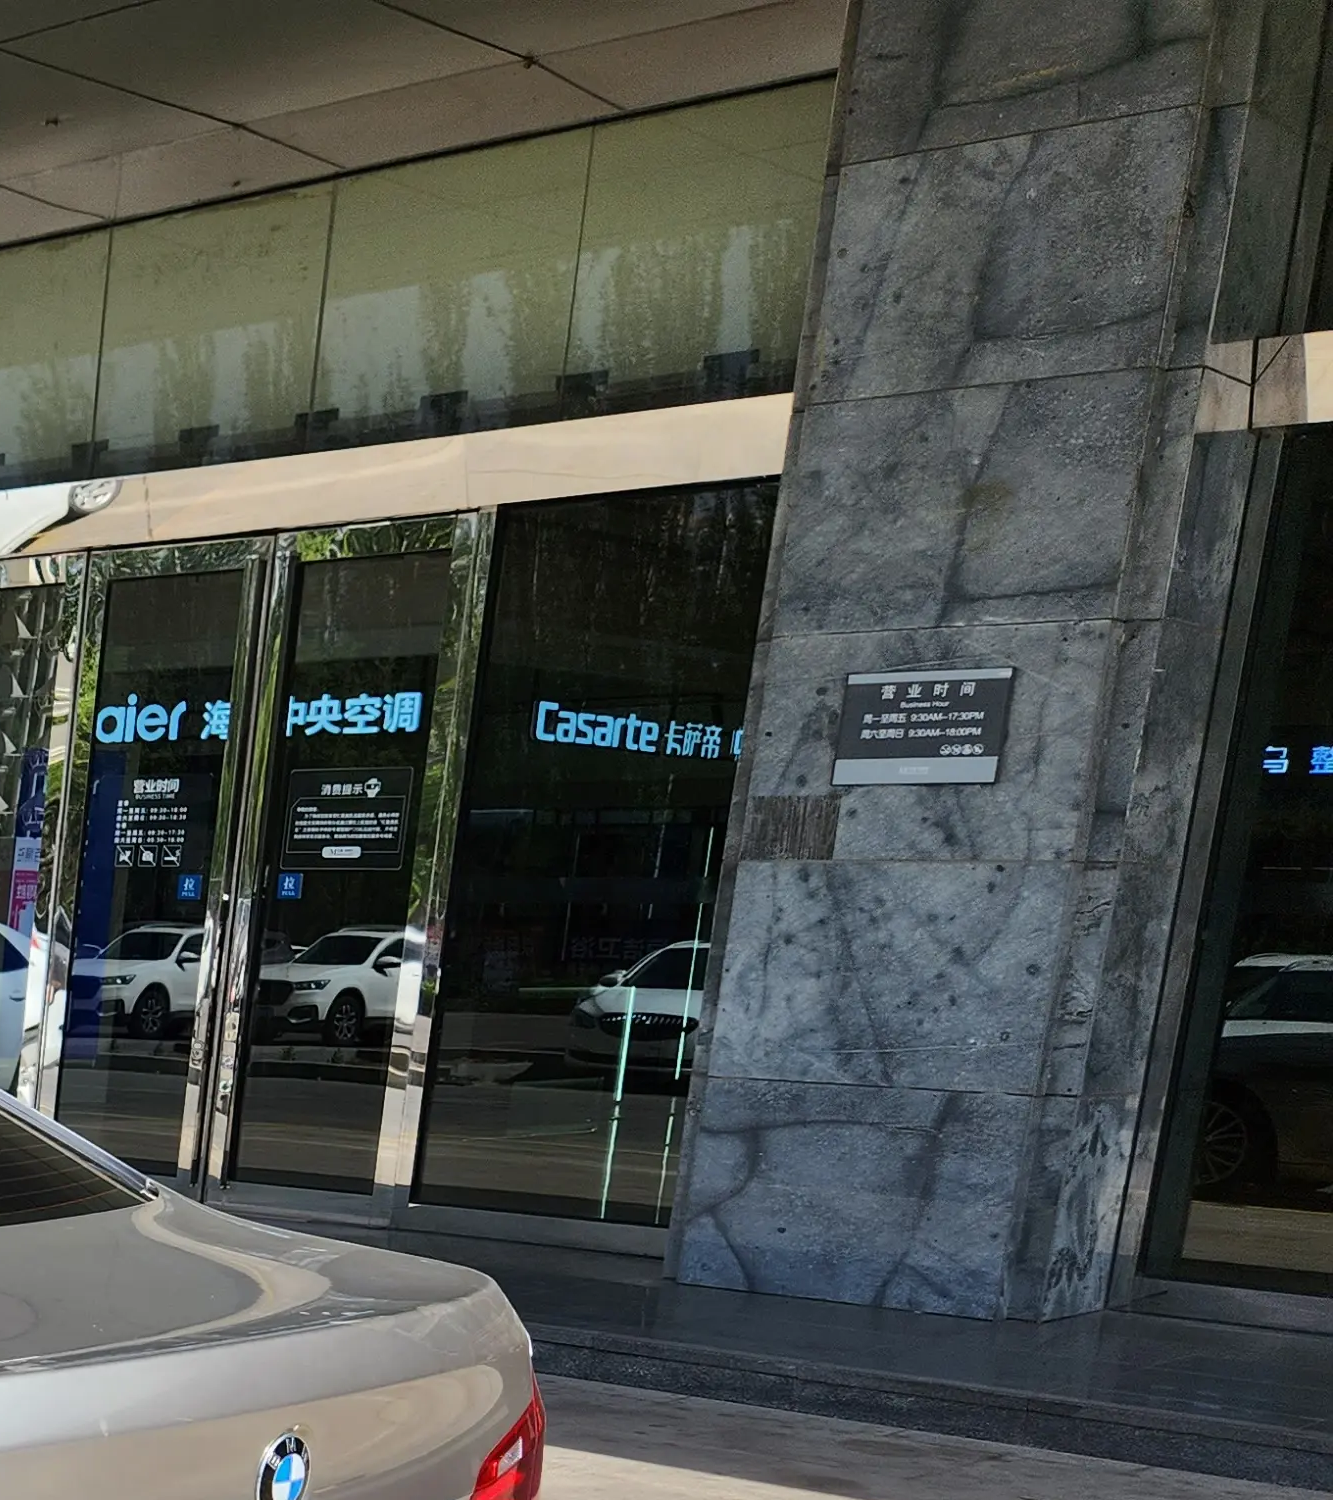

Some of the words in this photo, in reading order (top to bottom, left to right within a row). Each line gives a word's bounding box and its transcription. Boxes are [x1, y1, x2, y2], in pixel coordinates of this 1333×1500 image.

[880, 681, 977, 700] 营业时间
[95, 693, 186, 743] aier
[536, 700, 659, 753] Casarte
[664, 719, 723, 760] 卡萨帝
[133, 778, 180, 794] 营业时间
[320, 783, 364, 796] 消费提示
